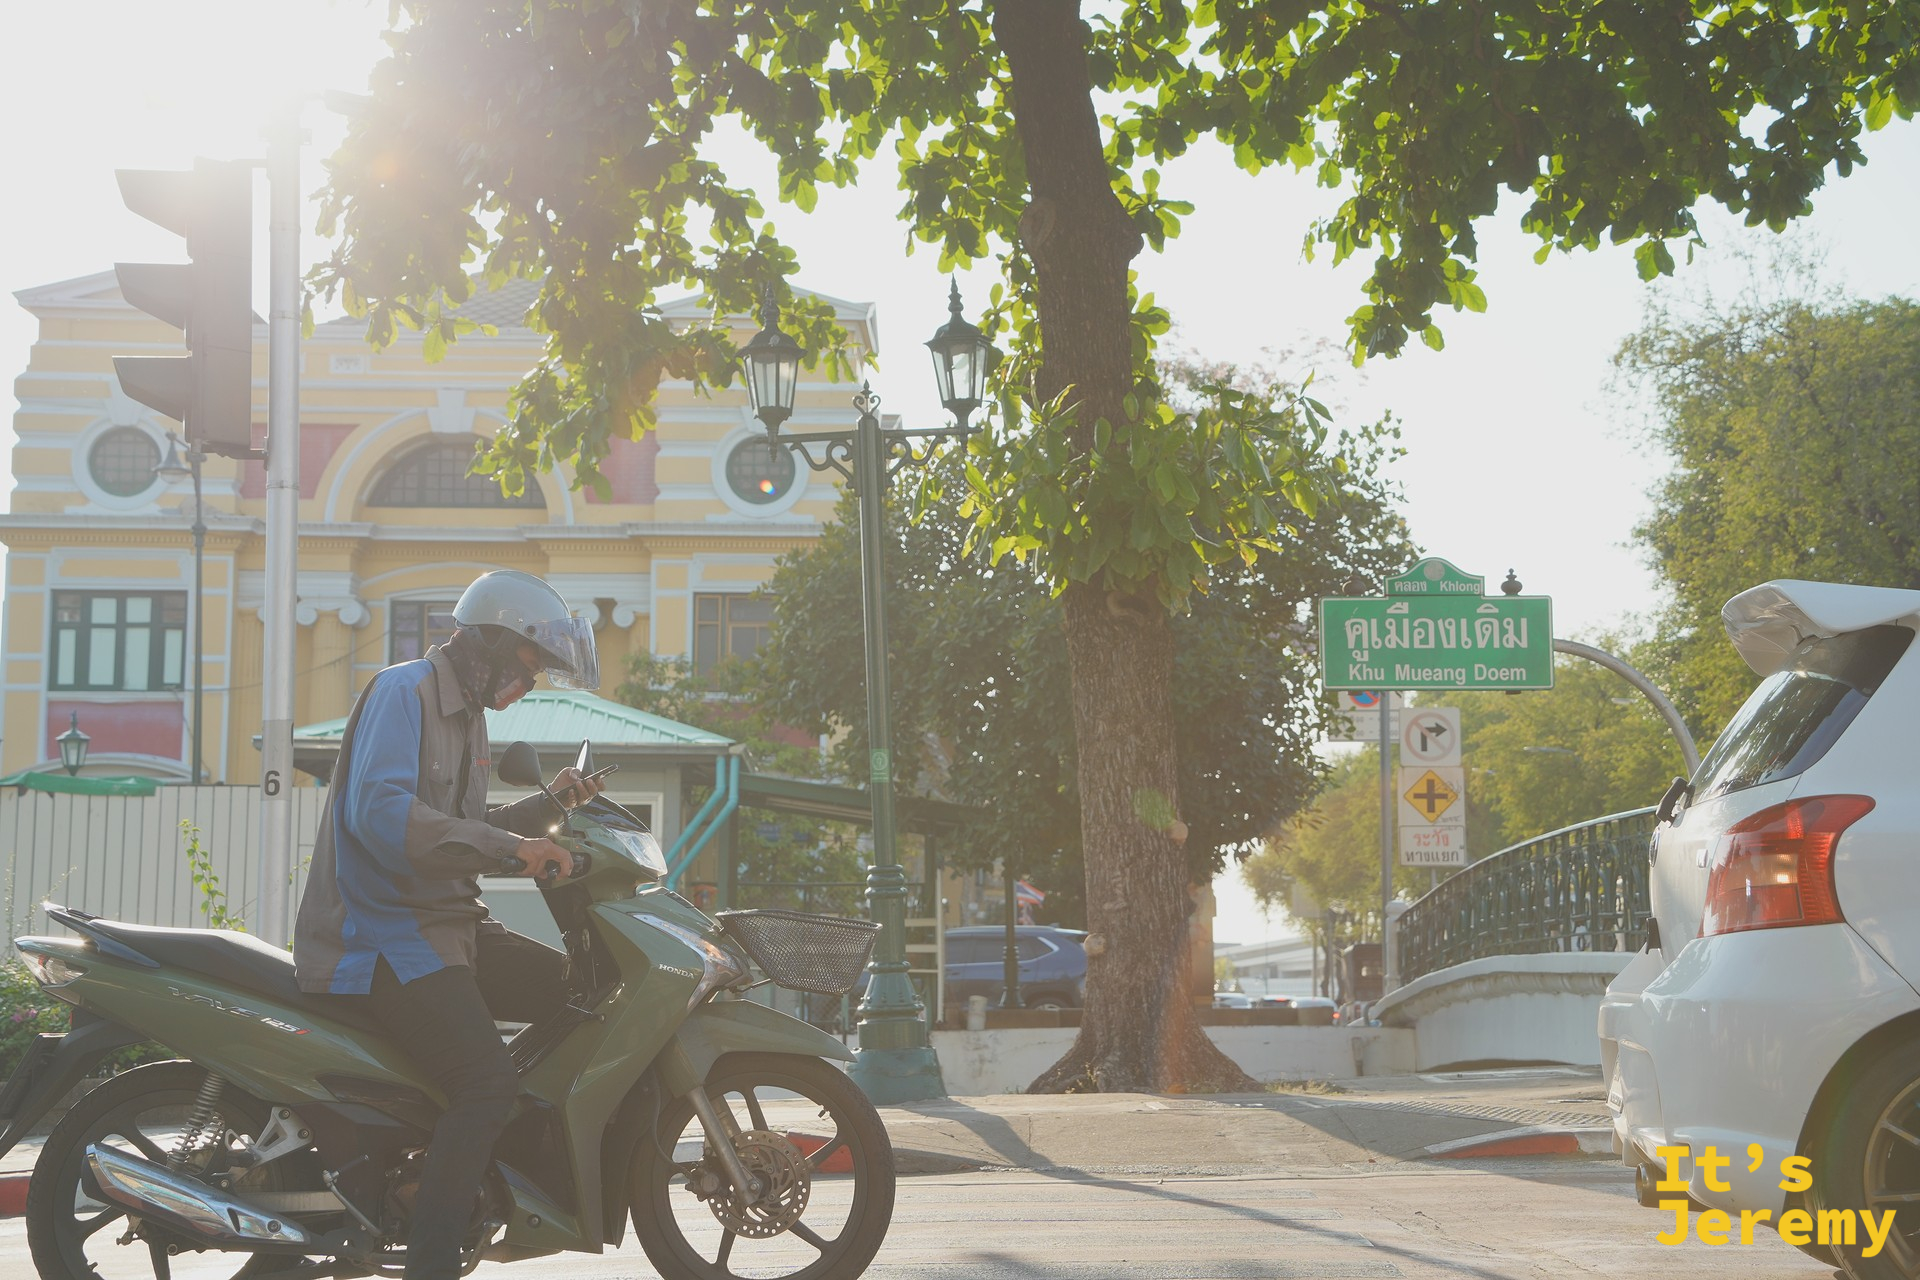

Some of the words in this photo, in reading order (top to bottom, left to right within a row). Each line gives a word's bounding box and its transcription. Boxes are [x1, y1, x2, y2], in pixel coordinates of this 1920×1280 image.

[1394, 581, 1427, 592] คลอง
[1440, 581, 1480, 594] Khlong
[1344, 602, 1528, 662] คูเมืองเดิม
[1349, 664, 1385, 681] Khu
[1395, 664, 1466, 685] Mueang
[1474, 664, 1526, 681] Doem
[264, 770, 280, 796] 6
[1413, 829, 1450, 847] ระวัง
[1405, 851, 1459, 862] ทางแยก
[658, 963, 695, 979] HONDA
